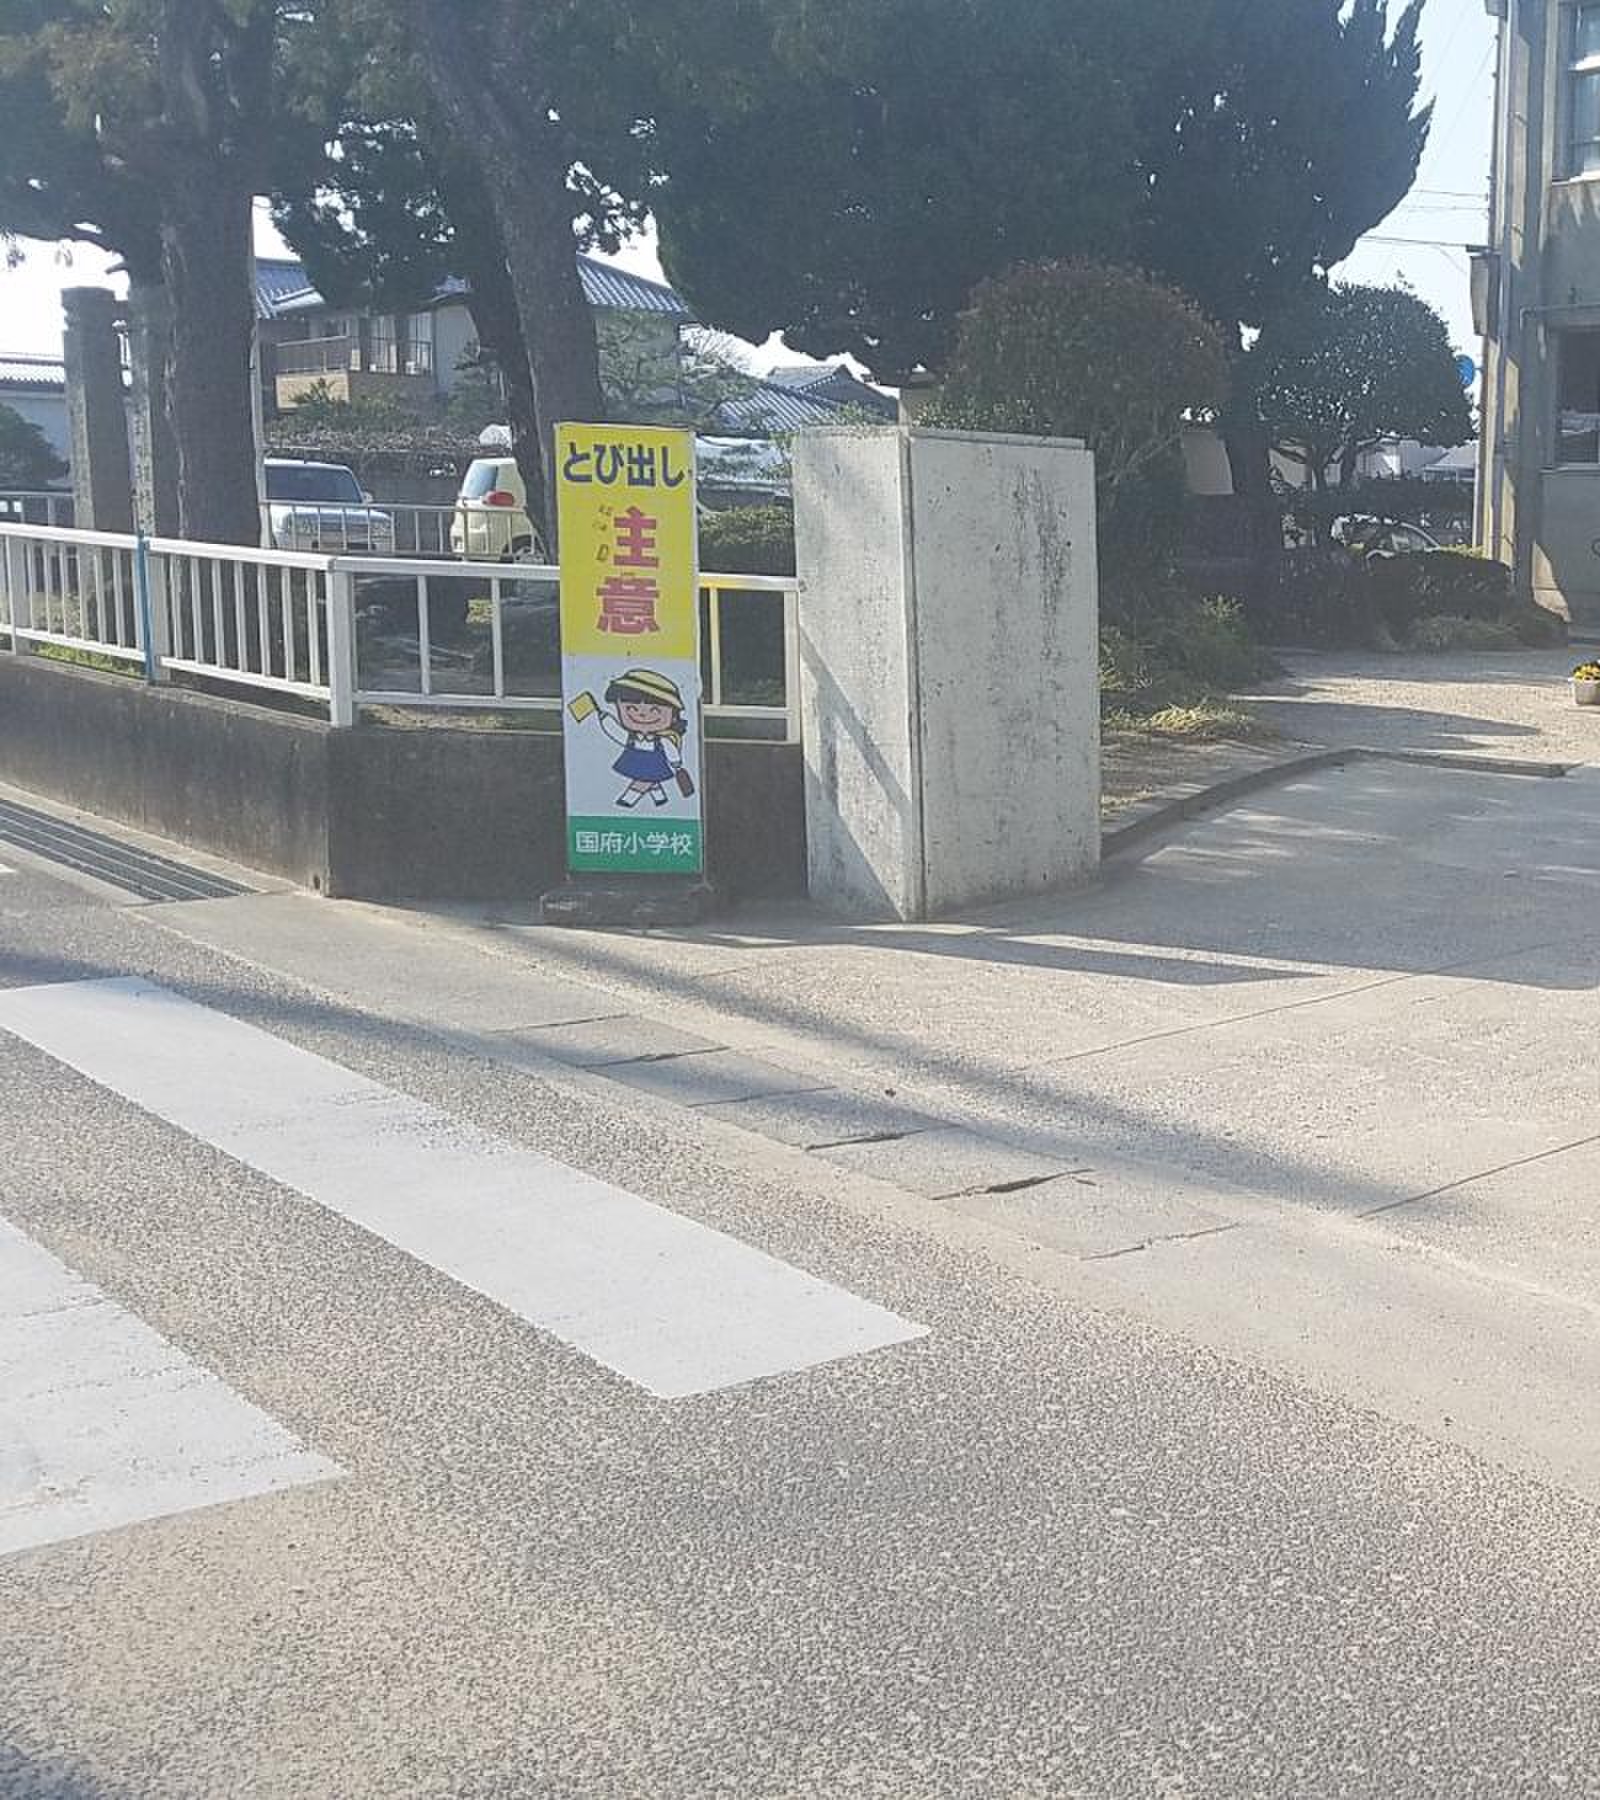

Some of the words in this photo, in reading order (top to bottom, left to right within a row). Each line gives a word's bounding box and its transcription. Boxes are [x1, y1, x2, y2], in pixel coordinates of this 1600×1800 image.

[563, 442, 687, 486] とび出し
[575, 831, 693, 856] 国府小学校
